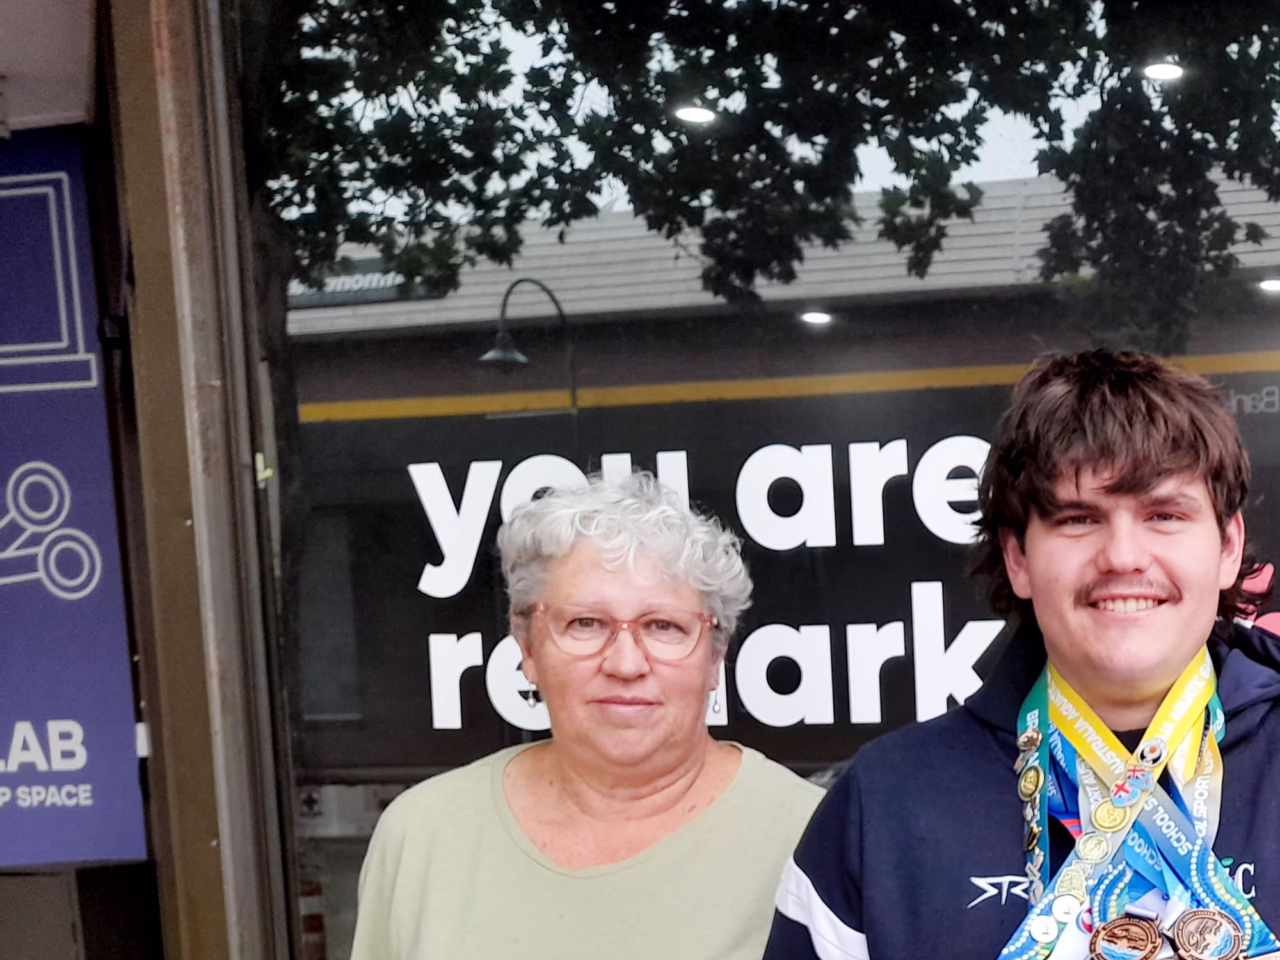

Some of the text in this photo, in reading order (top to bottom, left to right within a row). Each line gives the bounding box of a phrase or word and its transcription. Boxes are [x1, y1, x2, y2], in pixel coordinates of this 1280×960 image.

[736, 434, 995, 551] are
[0, 719, 88, 773] AB
[1074, 720, 1126, 775] AUSTRALIA
[16, 783, 94, 807] SPACE
[1151, 803, 1193, 857] SCHOOL
